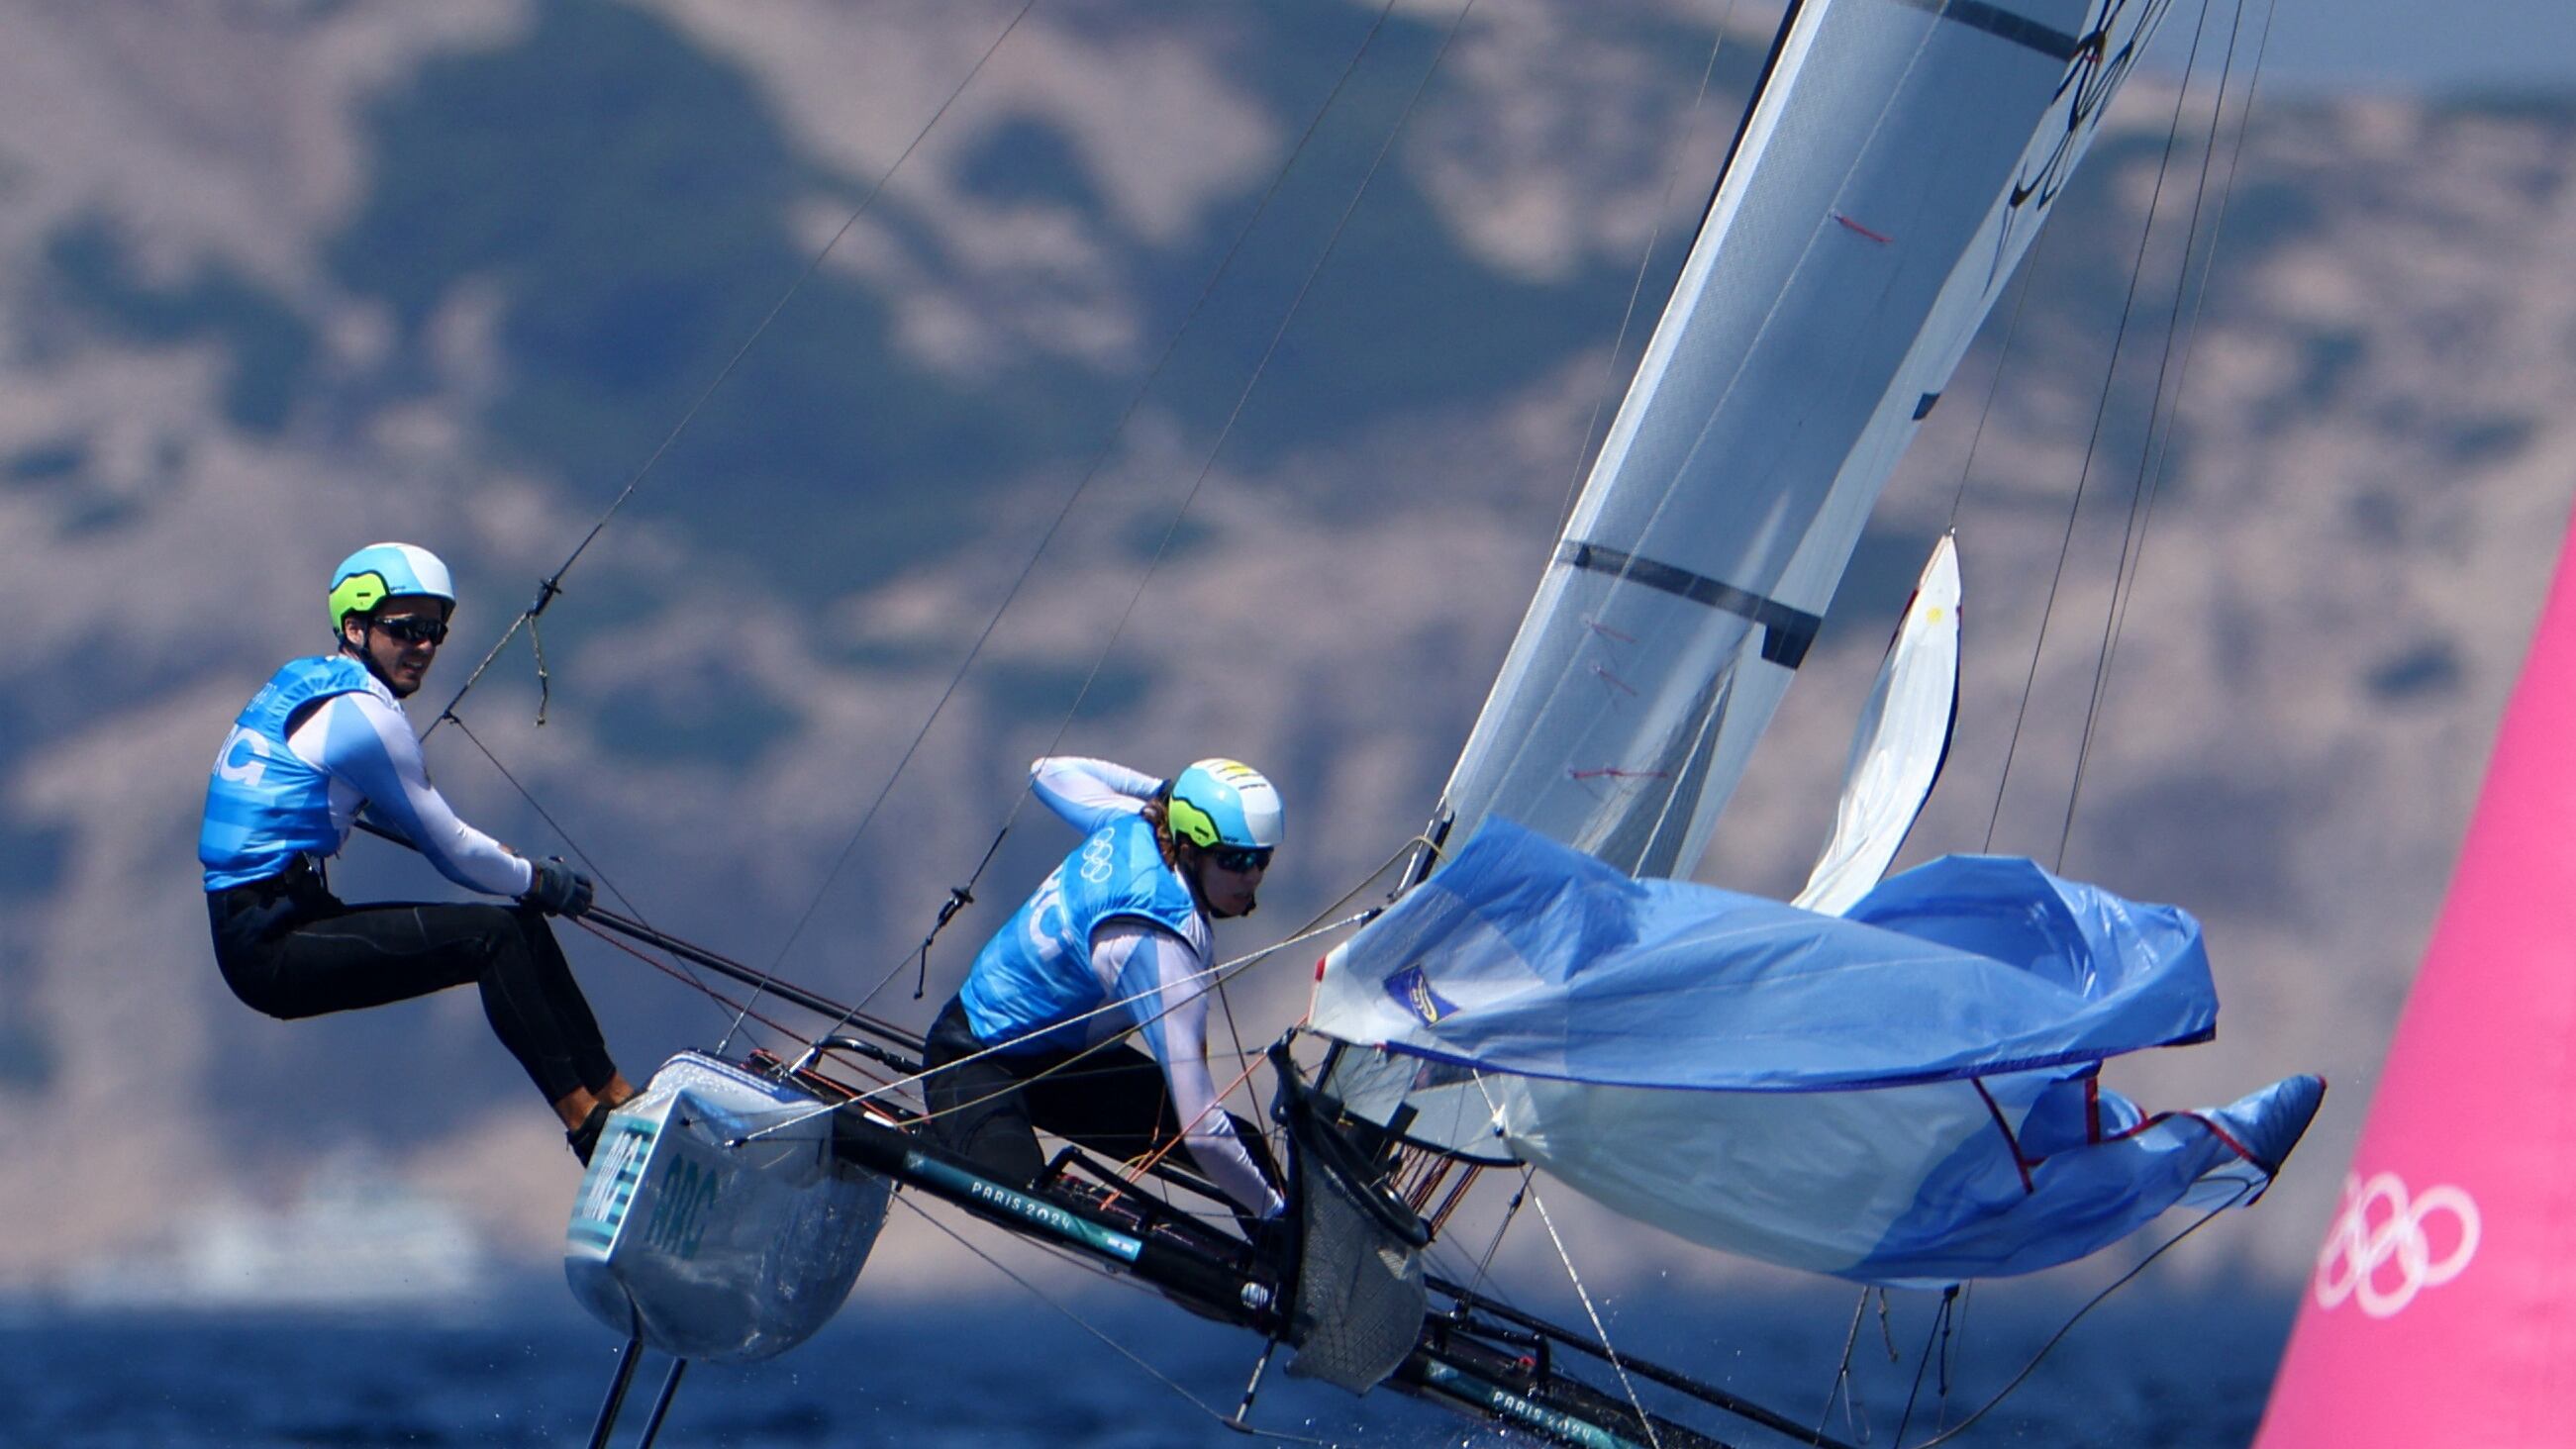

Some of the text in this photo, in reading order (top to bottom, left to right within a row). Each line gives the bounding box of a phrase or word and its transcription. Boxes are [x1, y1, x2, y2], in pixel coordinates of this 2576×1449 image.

[971, 1181, 1071, 1230] PARIS 2024
[1493, 1391, 1542, 1421] PARIS
